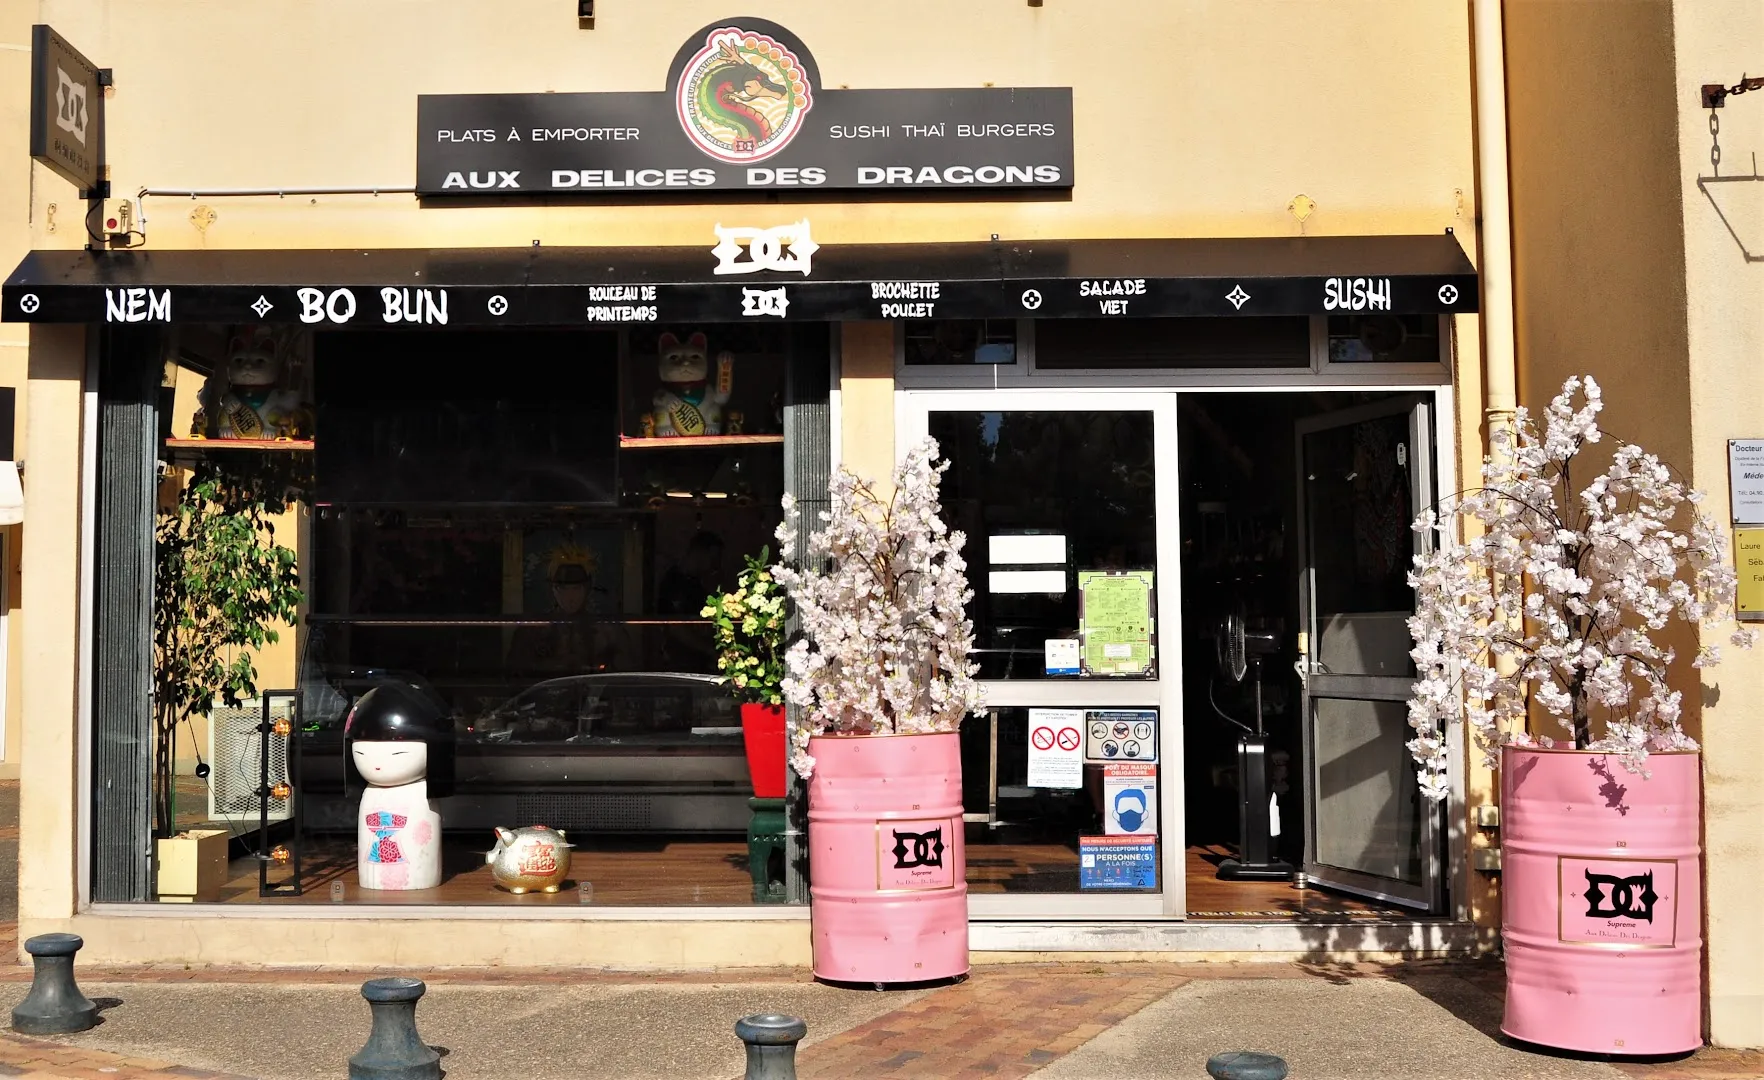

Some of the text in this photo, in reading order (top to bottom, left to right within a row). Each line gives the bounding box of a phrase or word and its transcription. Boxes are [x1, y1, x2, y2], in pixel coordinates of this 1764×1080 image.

[437, 126, 640, 142] PLATS À EMPORTER
[829, 123, 1055, 138] SUSHI THAÏ BURGERS
[706, 134, 732, 149] DELICES
[758, 138, 771, 147] DES
[441, 165, 1061, 188] AUX DELICES DES DRAGONS
[588, 286, 657, 301] ROULEAU DE
[871, 282, 940, 299] BROCHETTE
[1079, 279, 1147, 297] SALADE
[1323, 278, 1391, 311] SUSHI
[105, 287, 171, 323] NEM
[297, 287, 449, 325] BO BUN
[881, 303, 935, 318] POULET
[1099, 300, 1128, 315] VIET
[587, 305, 658, 322] PRINTEMPS
[1748, 557, 1764, 566] Séb
[1096, 853, 1153, 861] PERSONNE(S)
[1607, 920, 1636, 928] Supreme
